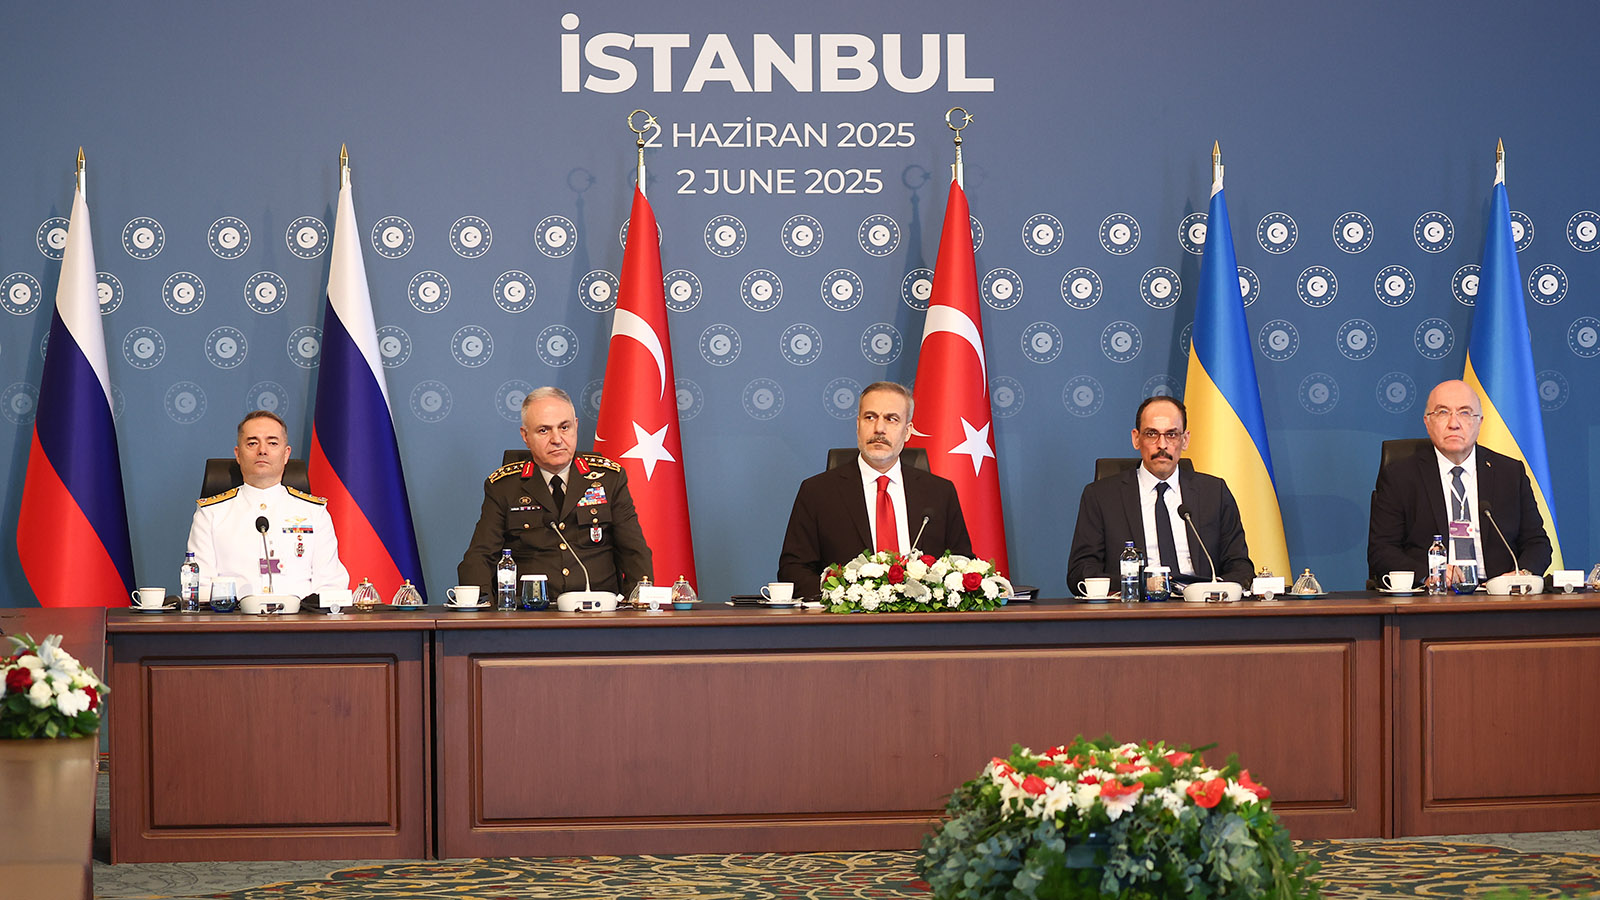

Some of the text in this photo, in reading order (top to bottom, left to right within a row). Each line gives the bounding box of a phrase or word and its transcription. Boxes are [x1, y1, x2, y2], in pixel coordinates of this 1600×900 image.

[560, 13, 995, 94] İSTANBUL
[642, 116, 916, 148] 2 HAZİRAN 2025
[676, 168, 883, 195] 2 JUNE 2025
